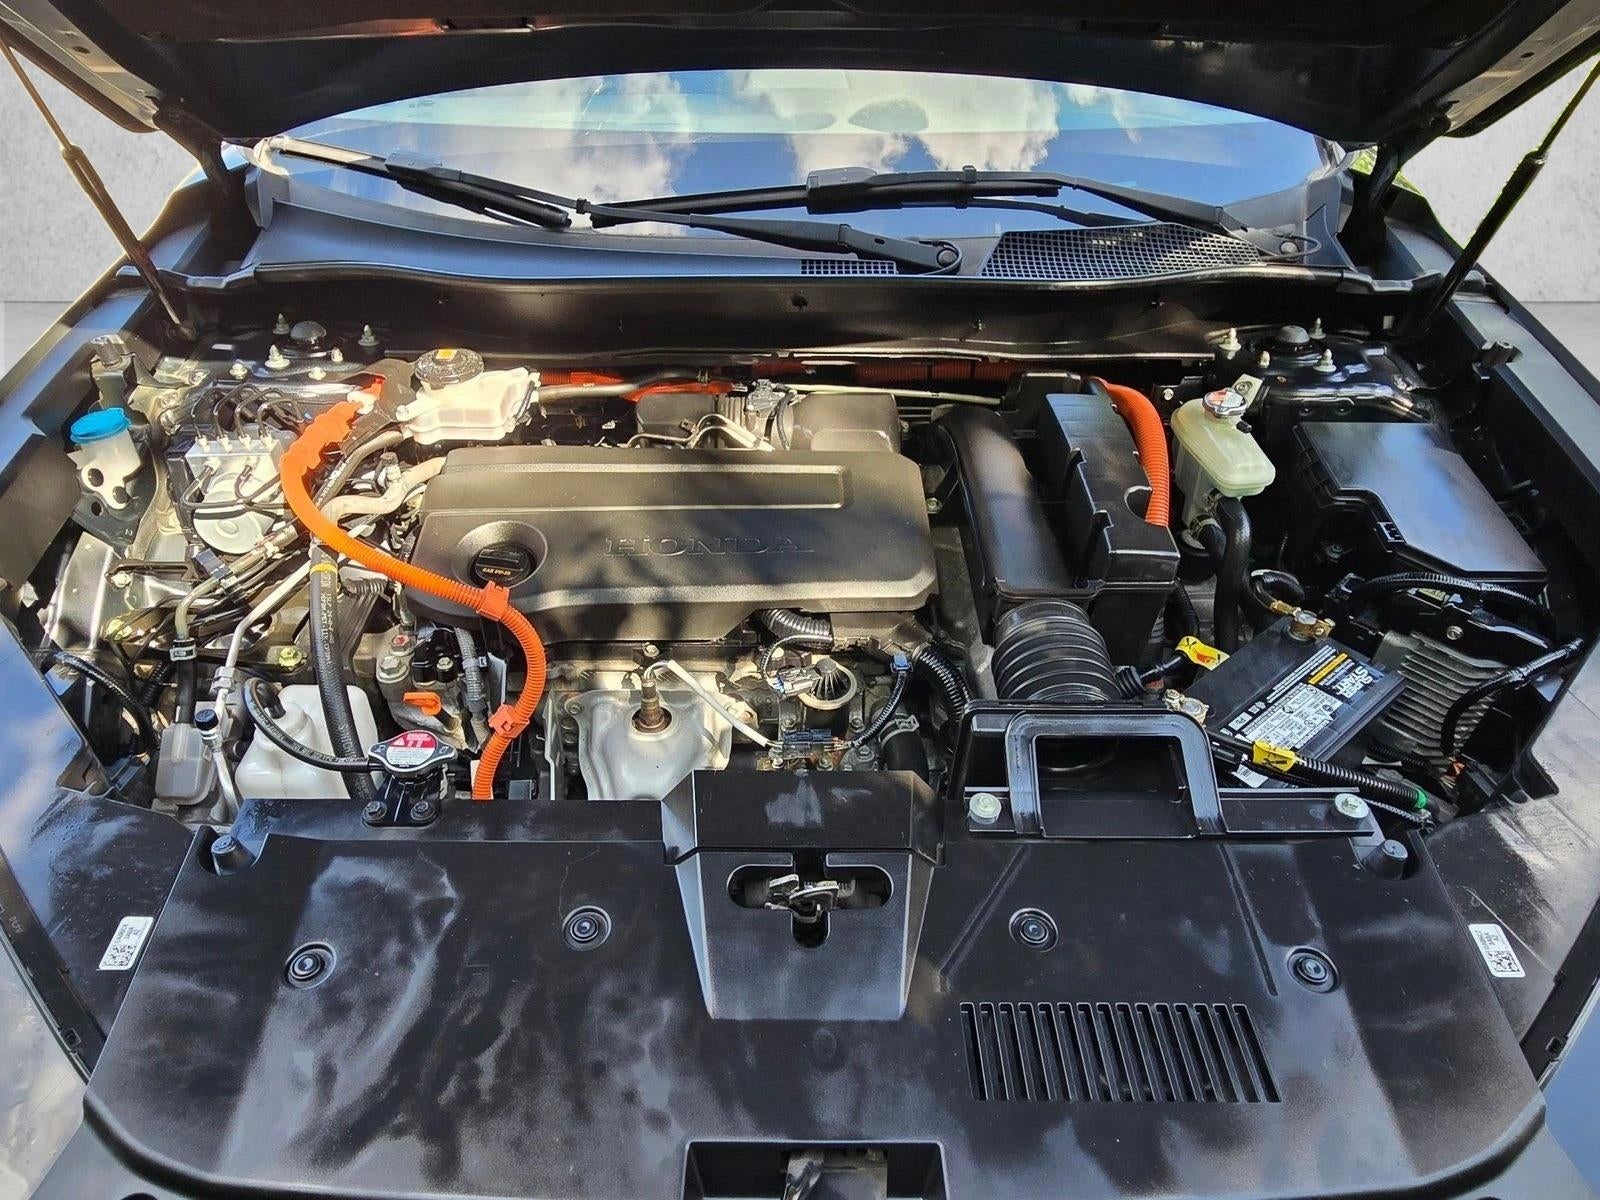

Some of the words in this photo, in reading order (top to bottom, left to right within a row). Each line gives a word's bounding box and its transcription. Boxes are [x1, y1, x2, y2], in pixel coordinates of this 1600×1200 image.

[604, 537, 815, 556] HONDA
[1332, 665, 1369, 696] START
[1340, 675, 1374, 699] SUPER
